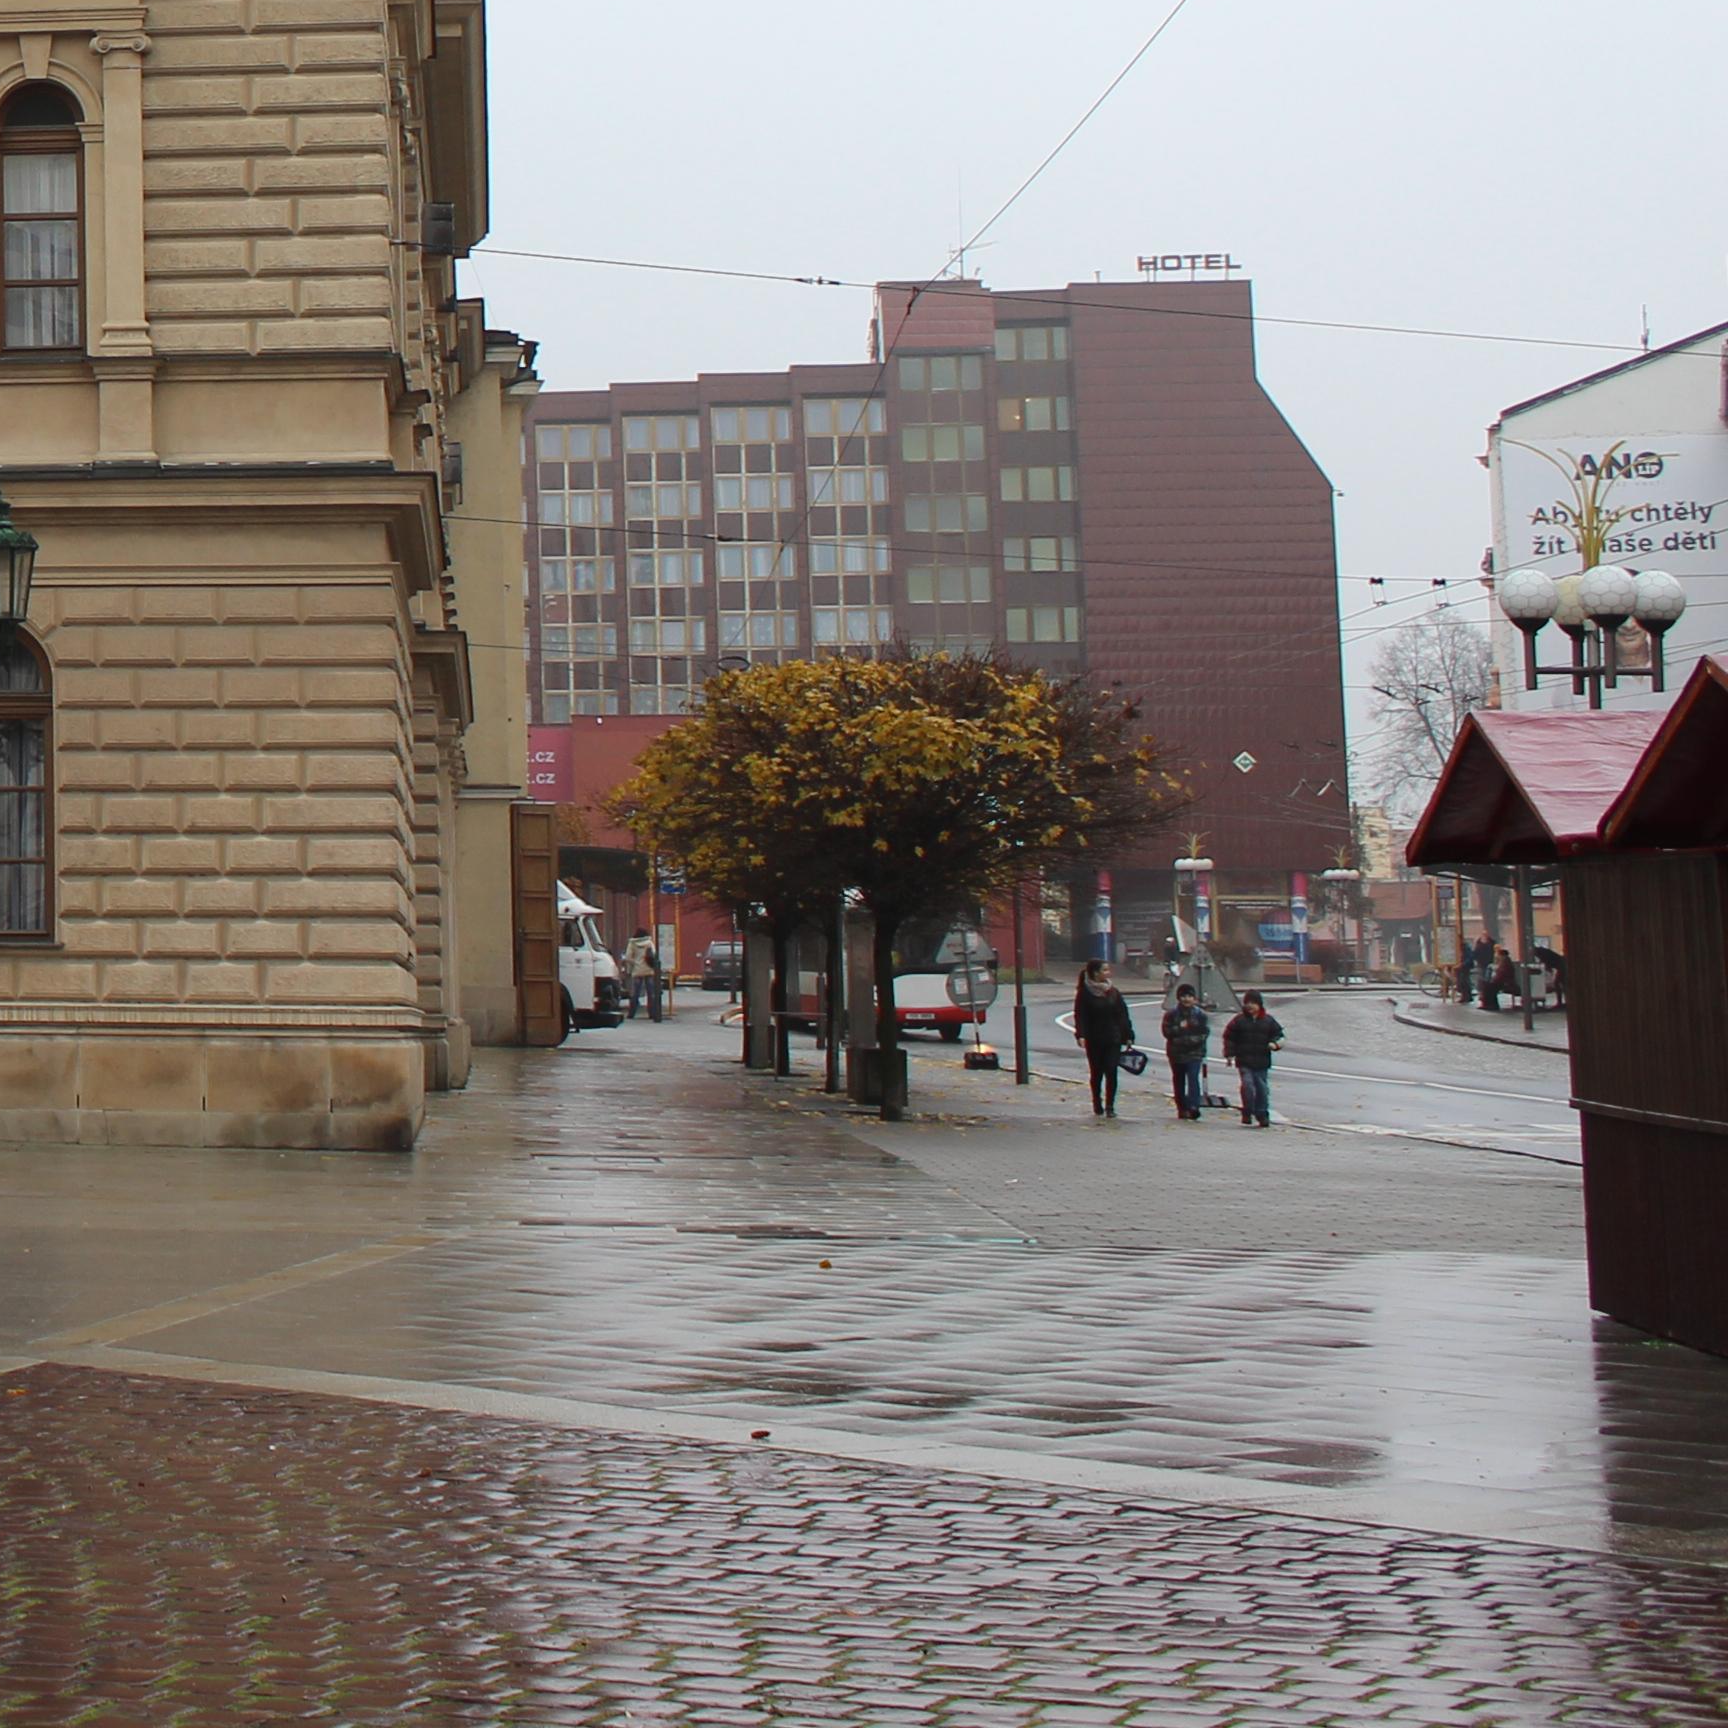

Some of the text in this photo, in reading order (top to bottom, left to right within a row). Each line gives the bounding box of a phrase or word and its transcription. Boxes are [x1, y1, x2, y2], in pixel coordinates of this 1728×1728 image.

[1136, 253, 1242, 272] HOTEL
[1630, 501, 1714, 524] chtěly
[1532, 535, 1566, 555] žít
[1662, 530, 1716, 551] děti
